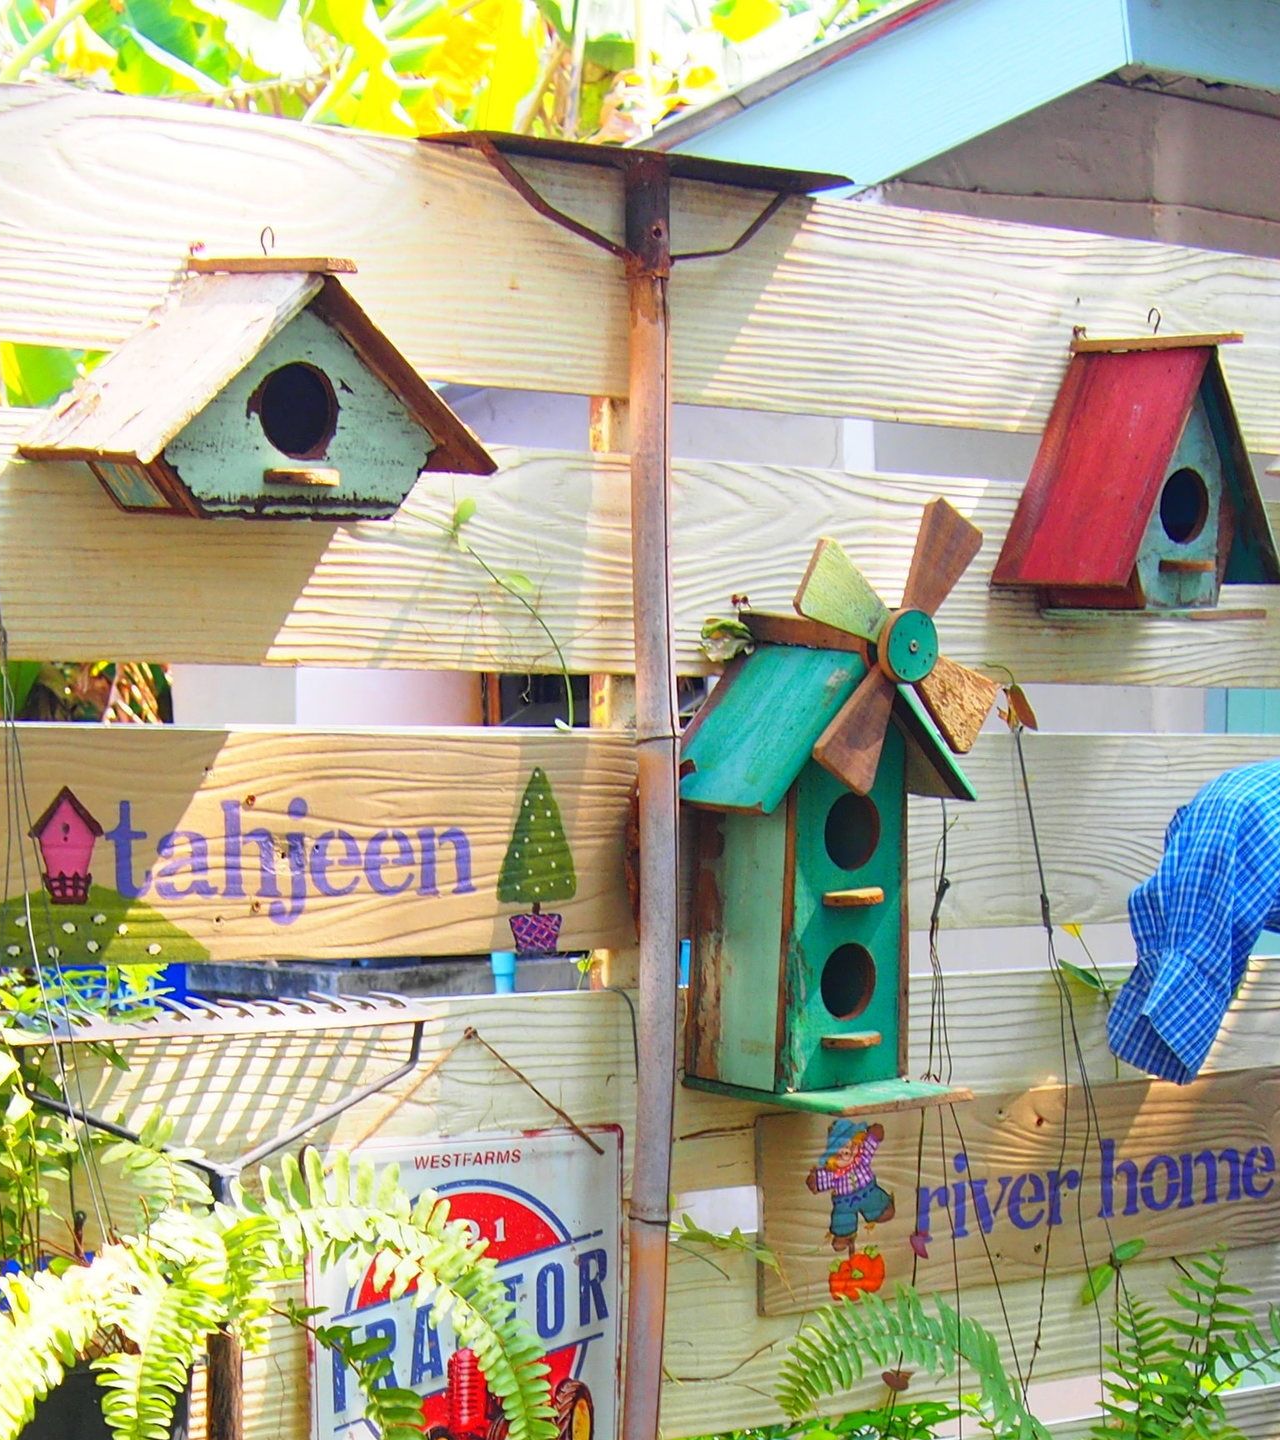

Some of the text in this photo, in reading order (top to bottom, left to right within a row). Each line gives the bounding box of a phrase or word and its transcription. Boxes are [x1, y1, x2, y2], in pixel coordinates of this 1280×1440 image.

[105, 797, 477, 925] tahjeen
[414, 1149, 522, 1170] WESTFARMS
[915, 1139, 1275, 1242] river home
[332, 1249, 609, 1413] TRATOR
